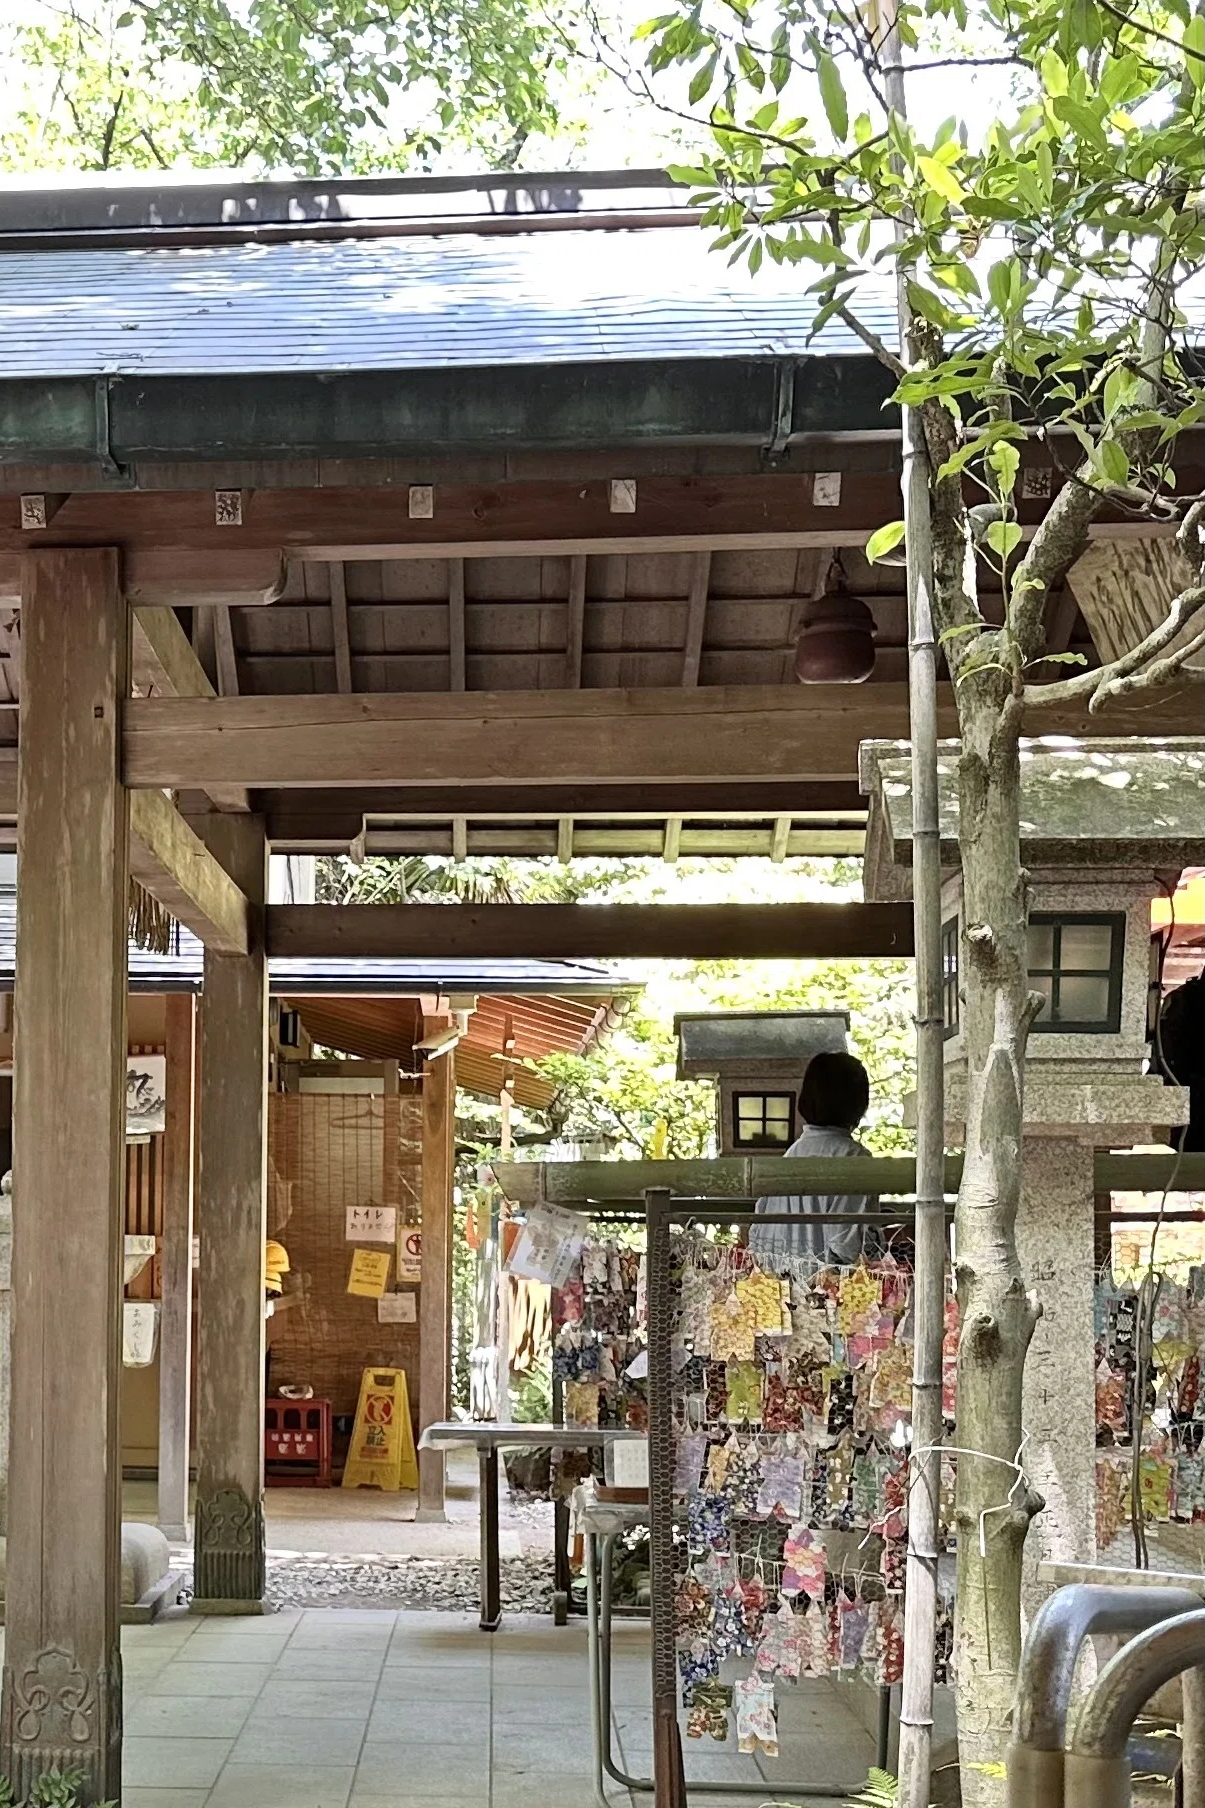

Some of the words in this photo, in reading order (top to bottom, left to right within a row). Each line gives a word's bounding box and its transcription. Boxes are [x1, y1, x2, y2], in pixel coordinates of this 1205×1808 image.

[353, 1209, 383, 1220] トイレ
[367, 1425, 386, 1436] 立入
[366, 1436, 385, 1447] 禁止
